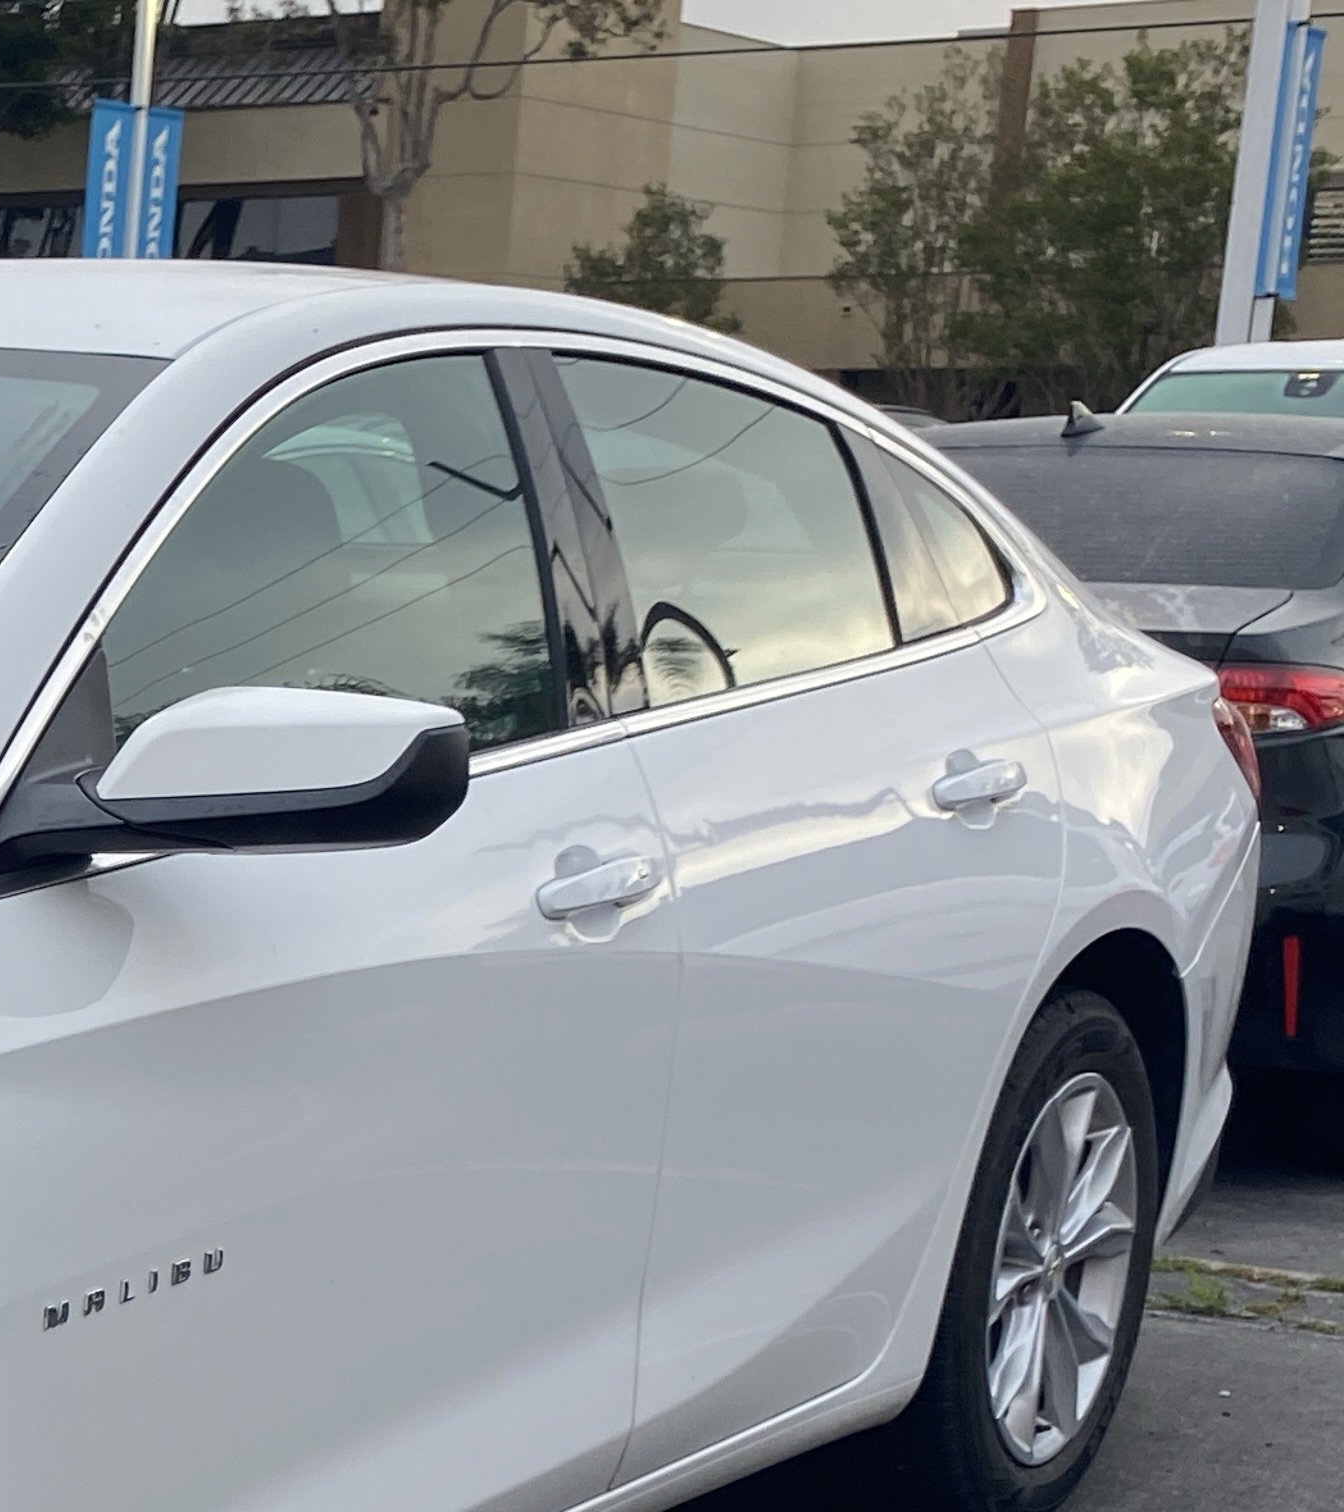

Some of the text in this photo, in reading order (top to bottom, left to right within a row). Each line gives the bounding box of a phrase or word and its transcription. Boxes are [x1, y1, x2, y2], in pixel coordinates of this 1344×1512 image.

[96, 119, 122, 259] ONDA
[145, 125, 170, 259] ONDA
[43, 1247, 224, 1331] MALIBU
